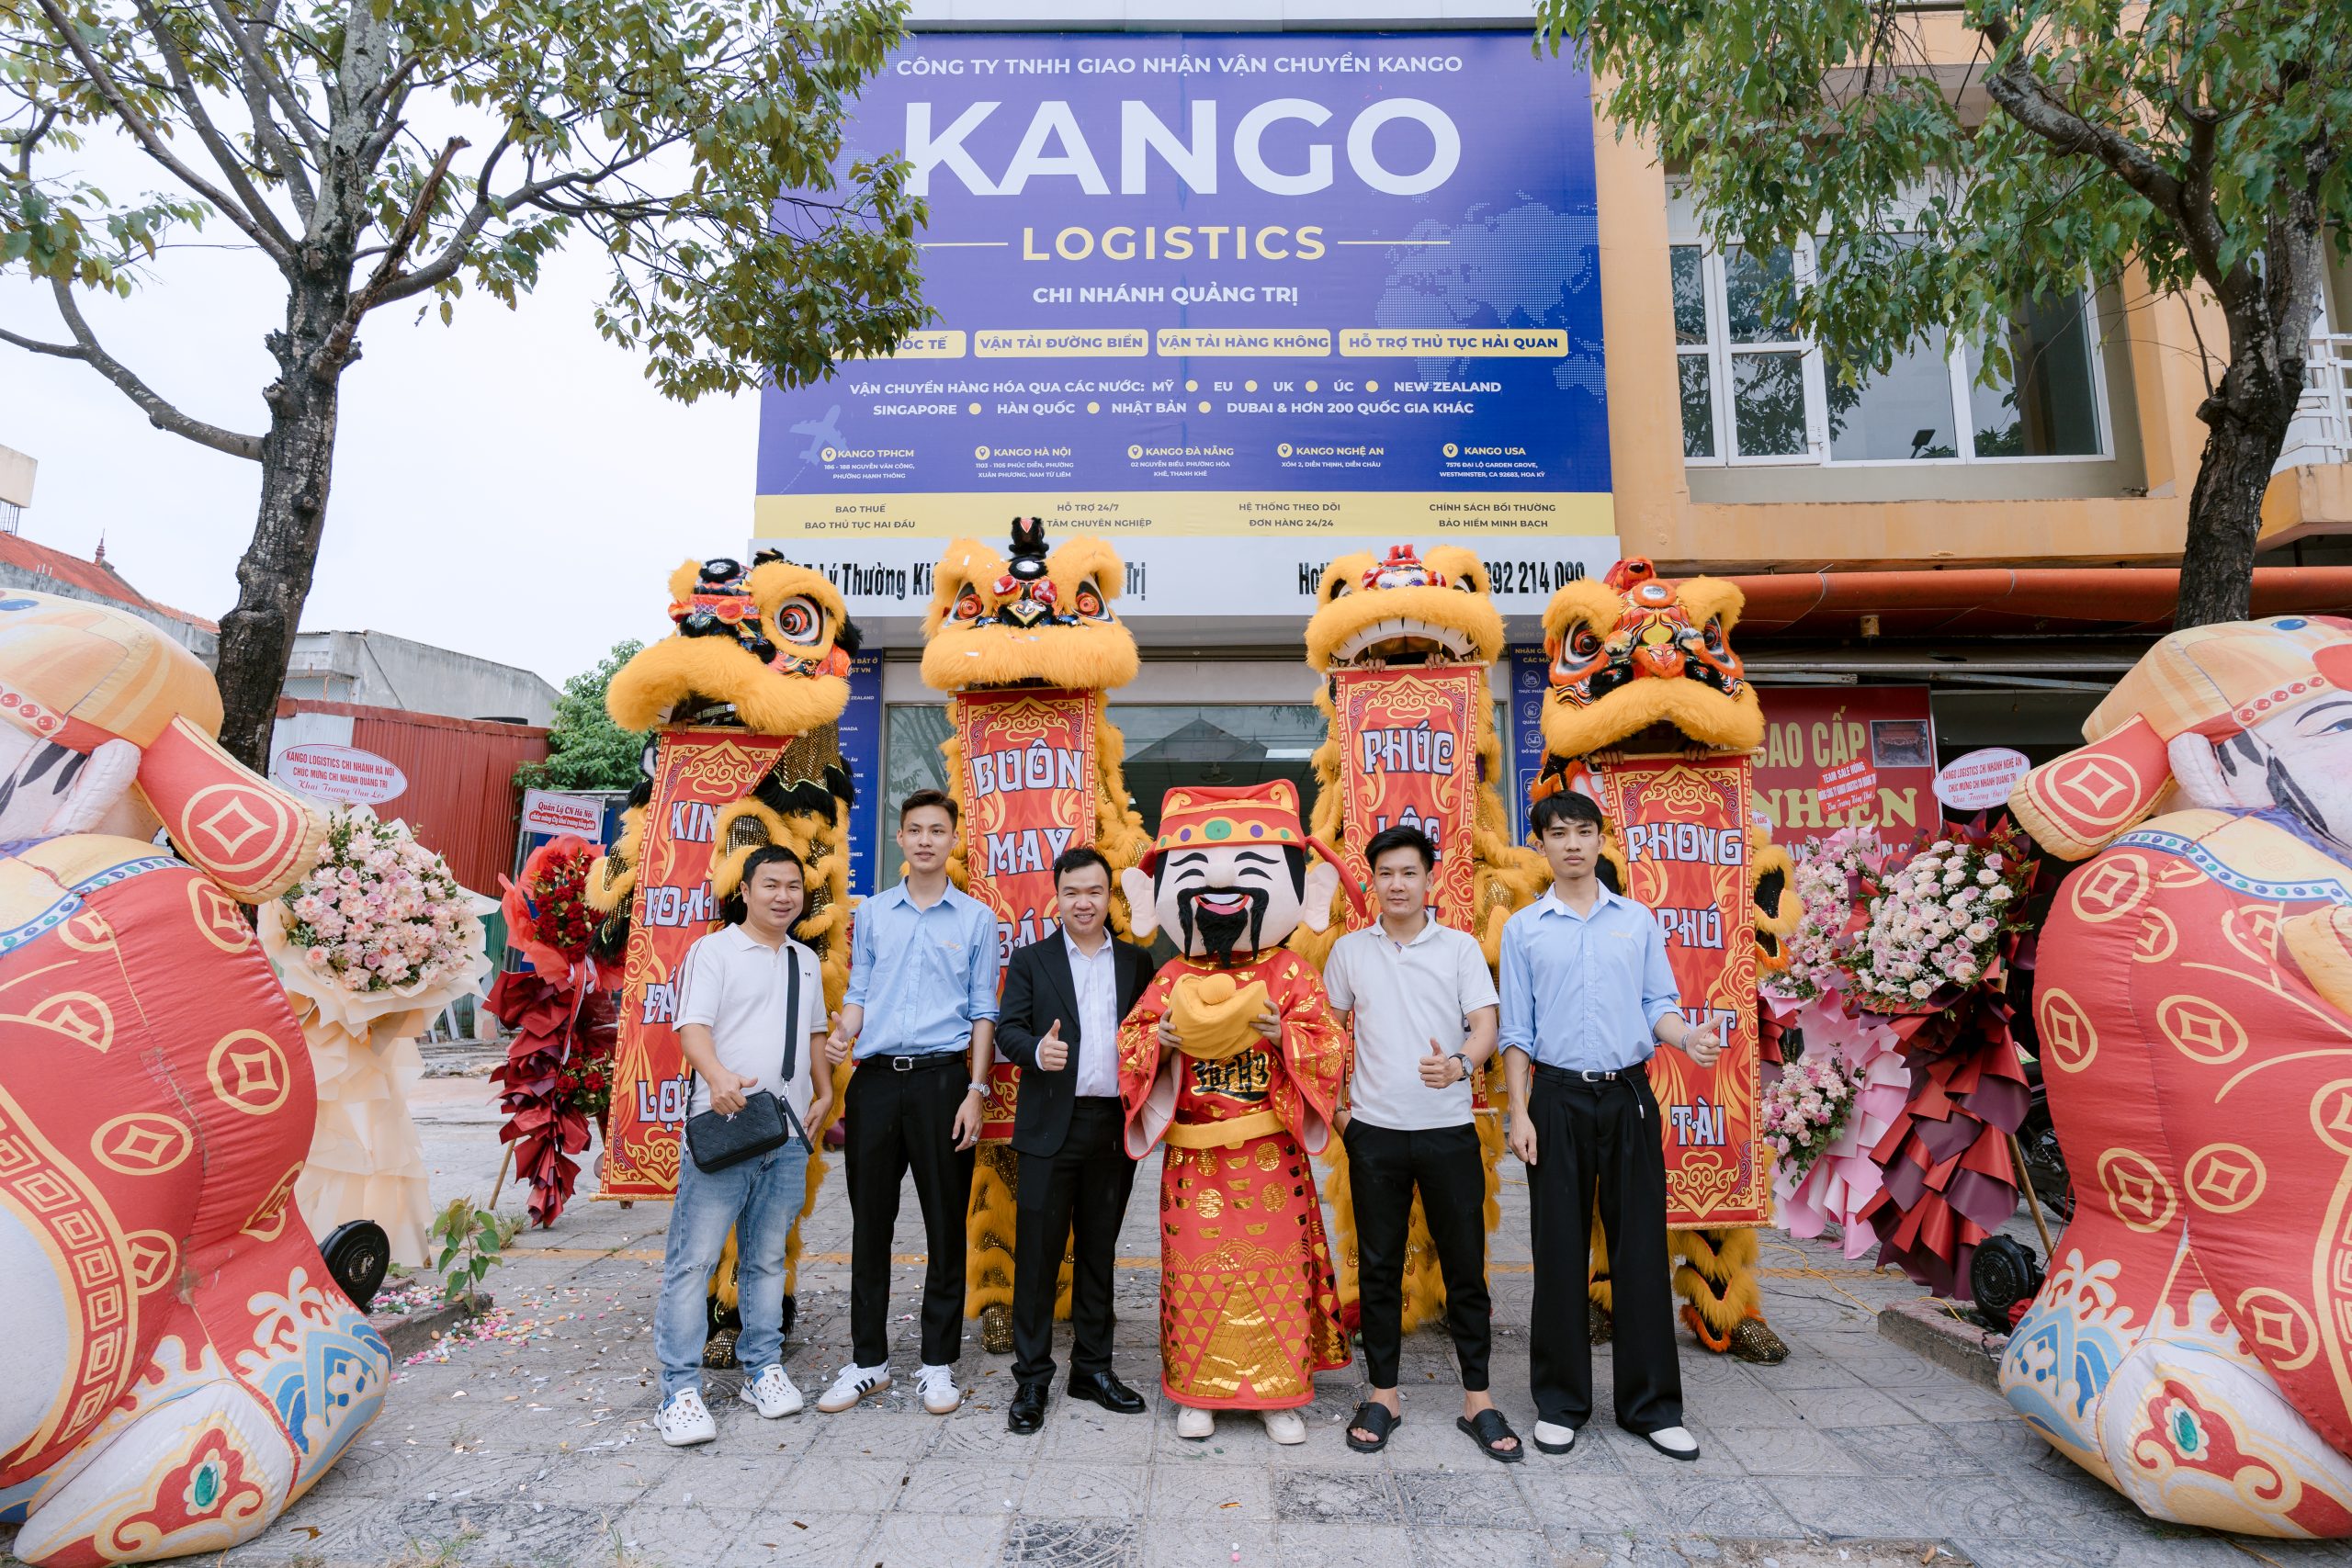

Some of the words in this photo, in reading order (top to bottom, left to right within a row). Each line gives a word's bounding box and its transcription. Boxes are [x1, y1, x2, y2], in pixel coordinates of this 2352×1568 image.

[897, 57, 963, 75] CÔNG
[971, 60, 999, 73] TY
[1005, 59, 1069, 73] TNHH
[1078, 58, 1136, 73] GIAO
[1144, 54, 1210, 76] NHẬN
[1217, 54, 1266, 76] VẬN
[1274, 51, 1370, 72] CHUYỂN
[1378, 57, 1462, 72] KANGO
[903, 97, 1463, 196] KANGO
[1023, 226, 1325, 260] LOGISTICS
[1033, 288, 1071, 303] CHI
[1080, 283, 1163, 302] NHÁNH
[1171, 281, 1255, 305] QUẢNG
[1261, 288, 1297, 306] TRỊ
[928, 336, 947, 349] TẾ
[980, 336, 1012, 351] VẬN
[1017, 334, 1041, 348] TẢI
[1046, 335, 1102, 348] ĐƯỜNG
[1107, 334, 1142, 347] BIỂN
[1159, 334, 1191, 351] VẬN
[1195, 334, 1219, 347] TẢI
[1225, 334, 1269, 348] HÀNG
[1272, 334, 1329, 348] KHÔNG
[1350, 333, 1371, 347] HỖ
[1376, 336, 1407, 350] TRỢ
[1412, 334, 1442, 347] THỦ
[1446, 337, 1478, 351] TỤC
[1483, 334, 1509, 347] HẢI
[1513, 337, 1559, 351] QUAN
[850, 382, 880, 397] VẬN
[885, 380, 943, 393] CHUYỂN
[947, 380, 989, 394] HÀNG
[993, 379, 1026, 393] HÓA
[1028, 382, 1062, 395] QUA
[1064, 379, 1095, 393] CÁC
[1098, 379, 1145, 392] NƯỚC:
[1151, 379, 1175, 392] MỸ
[1214, 381, 1234, 392] EU
[1272, 381, 1295, 392] UK
[1333, 378, 1354, 392] ÚC
[1394, 381, 1428, 393] NEW
[1431, 381, 1502, 393] ZEALAND
[873, 404, 957, 416] SINGAPORE
[997, 400, 1029, 414] HÀN
[1033, 400, 1075, 415] QUỐC
[1112, 400, 1152, 415] NHẬT
[1155, 400, 1187, 413] BẢN
[1227, 402, 1273, 413] DUBAI
[1276, 402, 1287, 413] &
[1291, 400, 1324, 413] HƠN
[1327, 402, 1354, 413] 200
[1358, 400, 1400, 415] QUỐC
[1403, 402, 1430, 414] GIA
[1433, 400, 1474, 413] KHÁC
[837, 449, 876, 458] KANGO
[876, 449, 914, 458] TPHCM
[993, 447, 1033, 457] KANGO
[1034, 446, 1050, 457] HÀ
[1052, 446, 1071, 458] NỘI
[1146, 447, 1184, 457] KANGO
[1184, 446, 1202, 456] ĐÀ
[1203, 445, 1234, 457] NẴNG
[1296, 446, 1335, 456] KANGO
[1336, 446, 1367, 457] NGHỆ
[1368, 447, 1385, 456] AN
[1464, 446, 1502, 456] KANGO
[1504, 446, 1527, 456] USA
[835, 505, 857, 513] BAO
[859, 502, 887, 513] THUẾ
[1057, 501, 1072, 512] HỖ
[1074, 502, 1095, 513] TRỢ
[1096, 502, 1120, 513] 24/7
[1238, 502, 1252, 513] HỆ
[1254, 501, 1291, 512] THỐNG
[1292, 503, 1320, 512] THEO
[1322, 502, 1340, 512] DÕI
[1429, 502, 1462, 512] CHÍNH
[1463, 502, 1491, 512] SÁCH
[1493, 502, 1511, 512] BỒI
[1512, 502, 1556, 512] THƯỜNG
[804, 521, 827, 530] BAO
[828, 519, 849, 529] THỦ
[851, 521, 872, 531] TỤC
[874, 521, 891, 529] HAI
[893, 518, 916, 528] ĐẦU
[1046, 518, 1069, 528] TÂM
[1070, 517, 1112, 528] CHUYÊN
[1114, 517, 1153, 529] NGHIỆP
[1249, 518, 1272, 527] ĐƠN
[1274, 517, 1304, 527] HÀNG
[1306, 518, 1334, 528] 24/24
[1438, 517, 1461, 527] BẢO
[1463, 517, 1489, 527] HIỂM
[1490, 520, 1518, 528] MINH
[1520, 520, 1548, 529] BẠCH
[842, 562, 906, 600] Thường
[1125, 562, 1146, 601] Trị
[1519, 561, 1550, 593] 214
[1811, 705, 1866, 768] CẤP
[1361, 720, 1454, 776] PHÚC
[287, 750, 308, 763] KANGO
[309, 756, 340, 769] LOGISTICS
[342, 760, 352, 771] CHI
[354, 760, 374, 774] NHÁNH
[375, 763, 384, 775] HÀ
[385, 764, 395, 779] NỘI
[970, 738, 1084, 799] BUÔN
[1838, 766, 1850, 779] SALE
[329, 772, 339, 781] CHI
[556, 804, 564, 815] Lý
[564, 806, 574, 815] CN
[1624, 822, 1745, 866] PHONG
[985, 828, 1074, 877] MAY
[1655, 902, 1724, 950] PHÚ
[1670, 1095, 1727, 1146] TÀI
